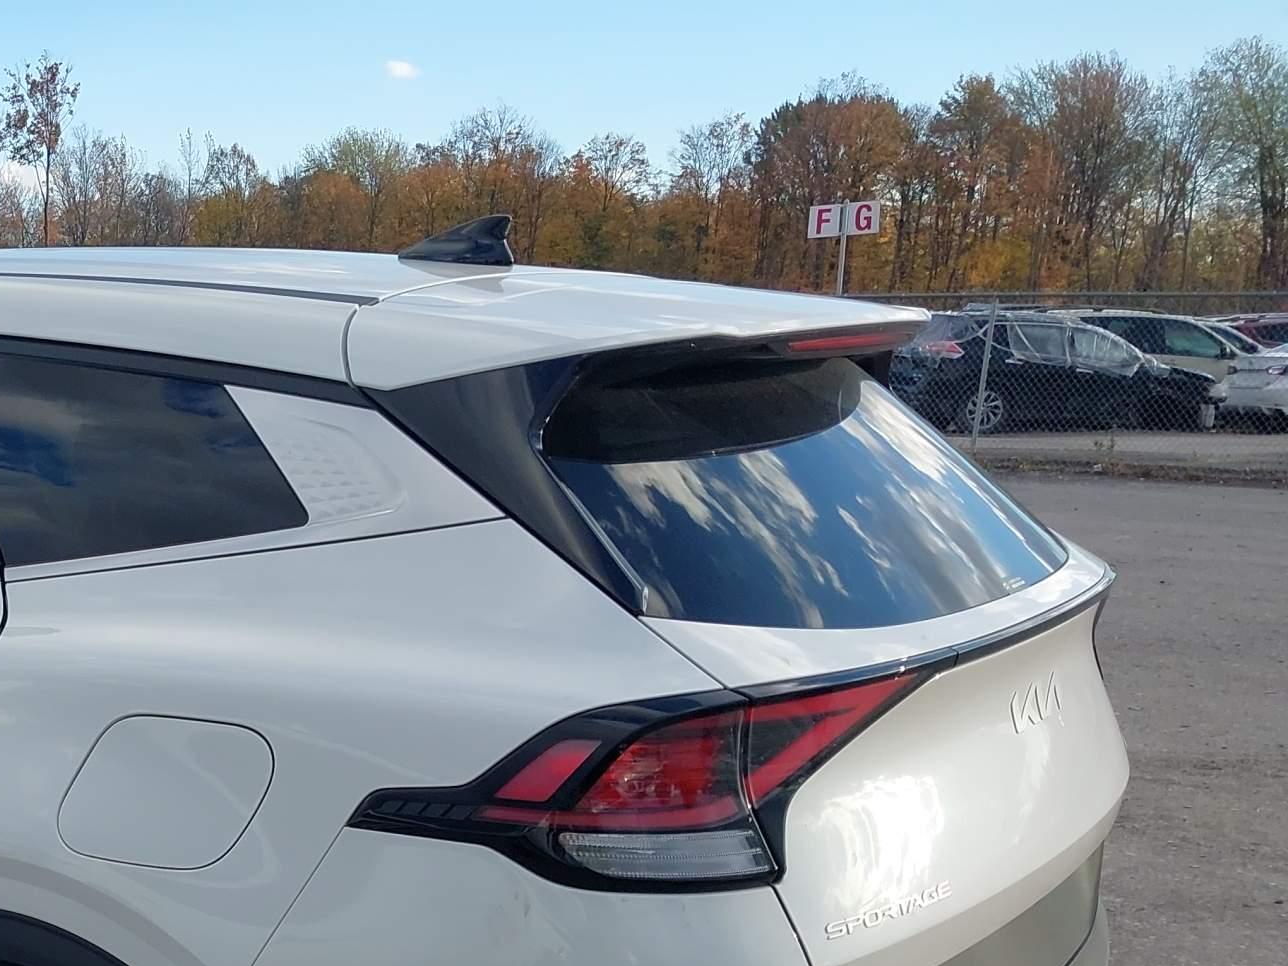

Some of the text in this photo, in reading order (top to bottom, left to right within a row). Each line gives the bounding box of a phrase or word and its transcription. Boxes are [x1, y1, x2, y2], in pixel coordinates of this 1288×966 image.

[816, 208, 832, 235] F
[855, 203, 872, 231] G
[823, 880, 953, 941] SPORTAGE
